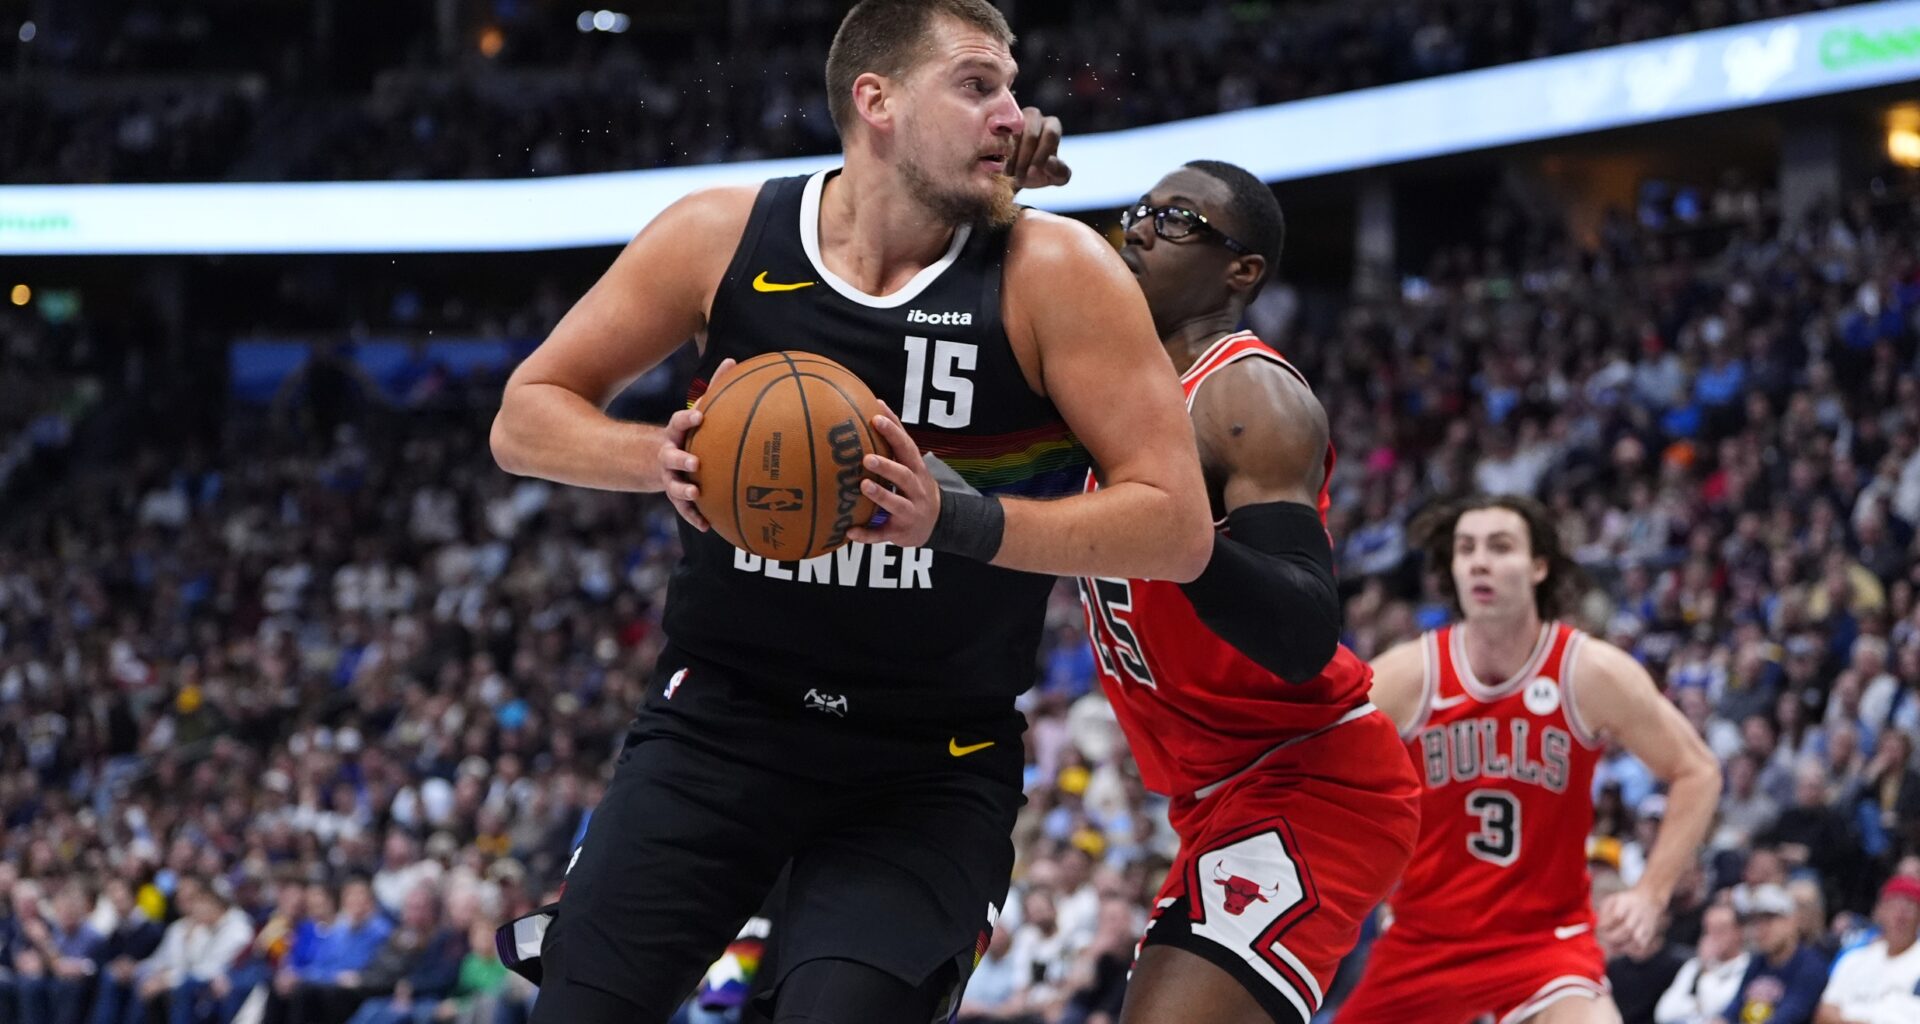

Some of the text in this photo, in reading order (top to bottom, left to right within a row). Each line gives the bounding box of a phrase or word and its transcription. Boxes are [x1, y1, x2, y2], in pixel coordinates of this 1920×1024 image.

[906, 309, 973, 326] ibotta
[901, 335, 979, 429] 15
[1421, 717, 1571, 795] BULLS
[1465, 788, 1522, 868] 3
